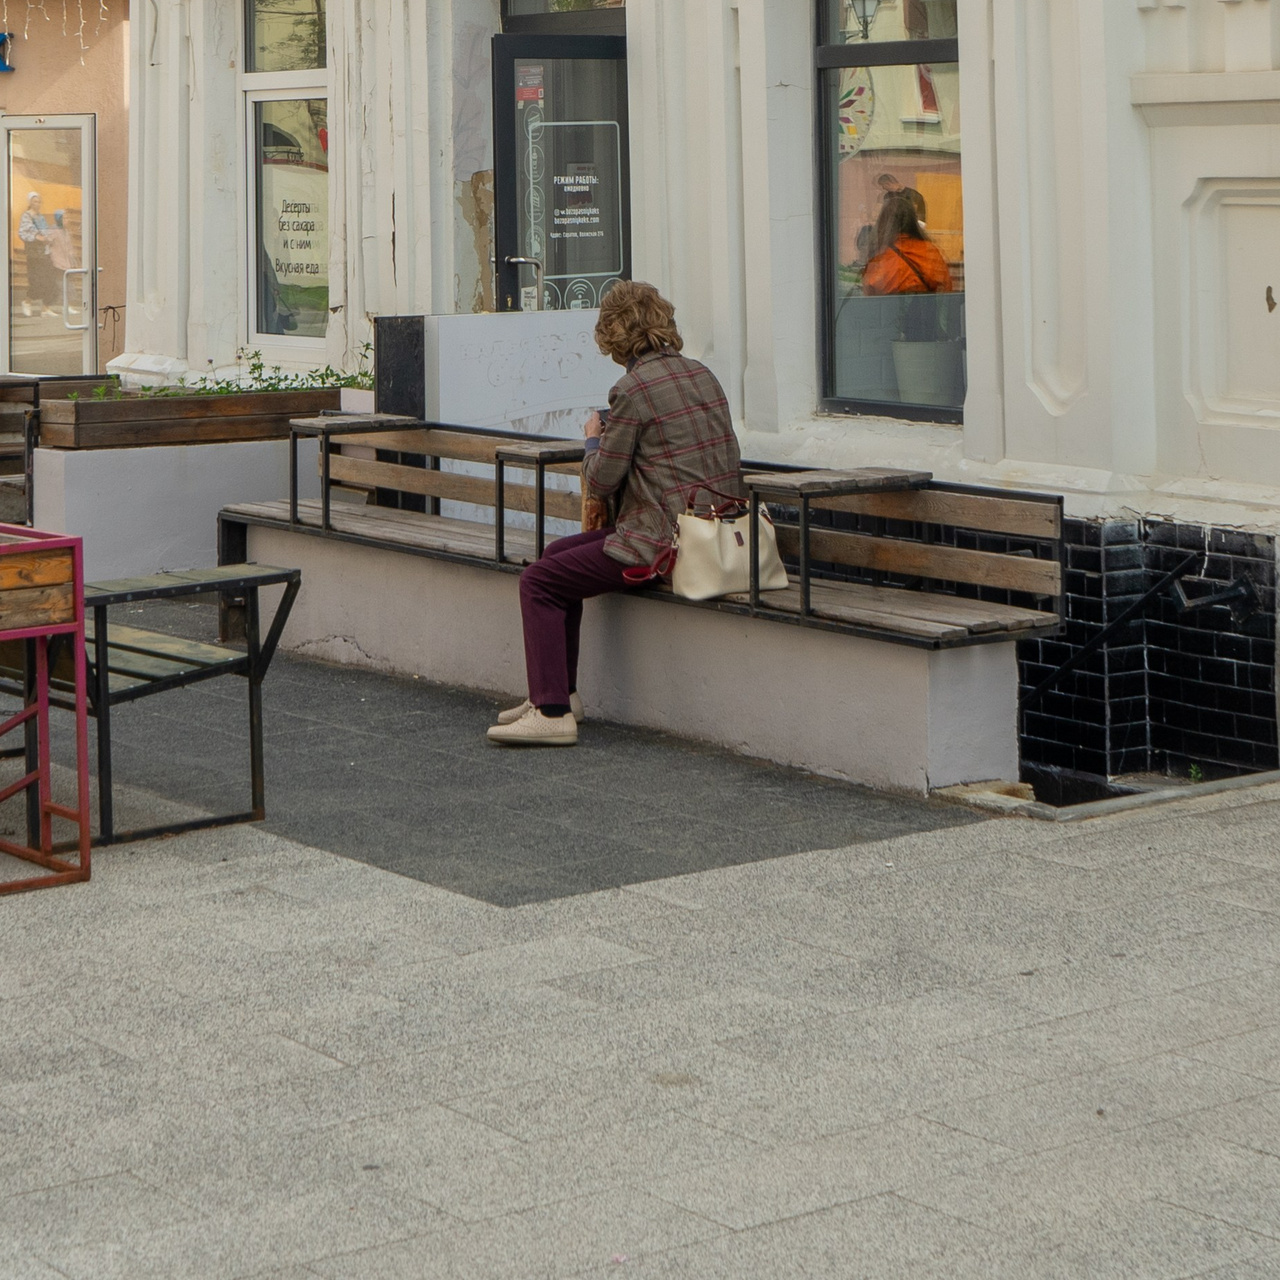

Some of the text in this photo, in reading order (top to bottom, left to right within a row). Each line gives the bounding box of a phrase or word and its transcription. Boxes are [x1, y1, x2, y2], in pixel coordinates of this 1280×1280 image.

[554, 175, 600, 185] РЕЖИМ РАБОТЫ:
[282, 199, 311, 218] Десерты
[278, 216, 315, 236] без сахара
[283, 239, 289, 250] и
[296, 238, 312, 250] ним
[275, 258, 320, 278] Вкусная еда
